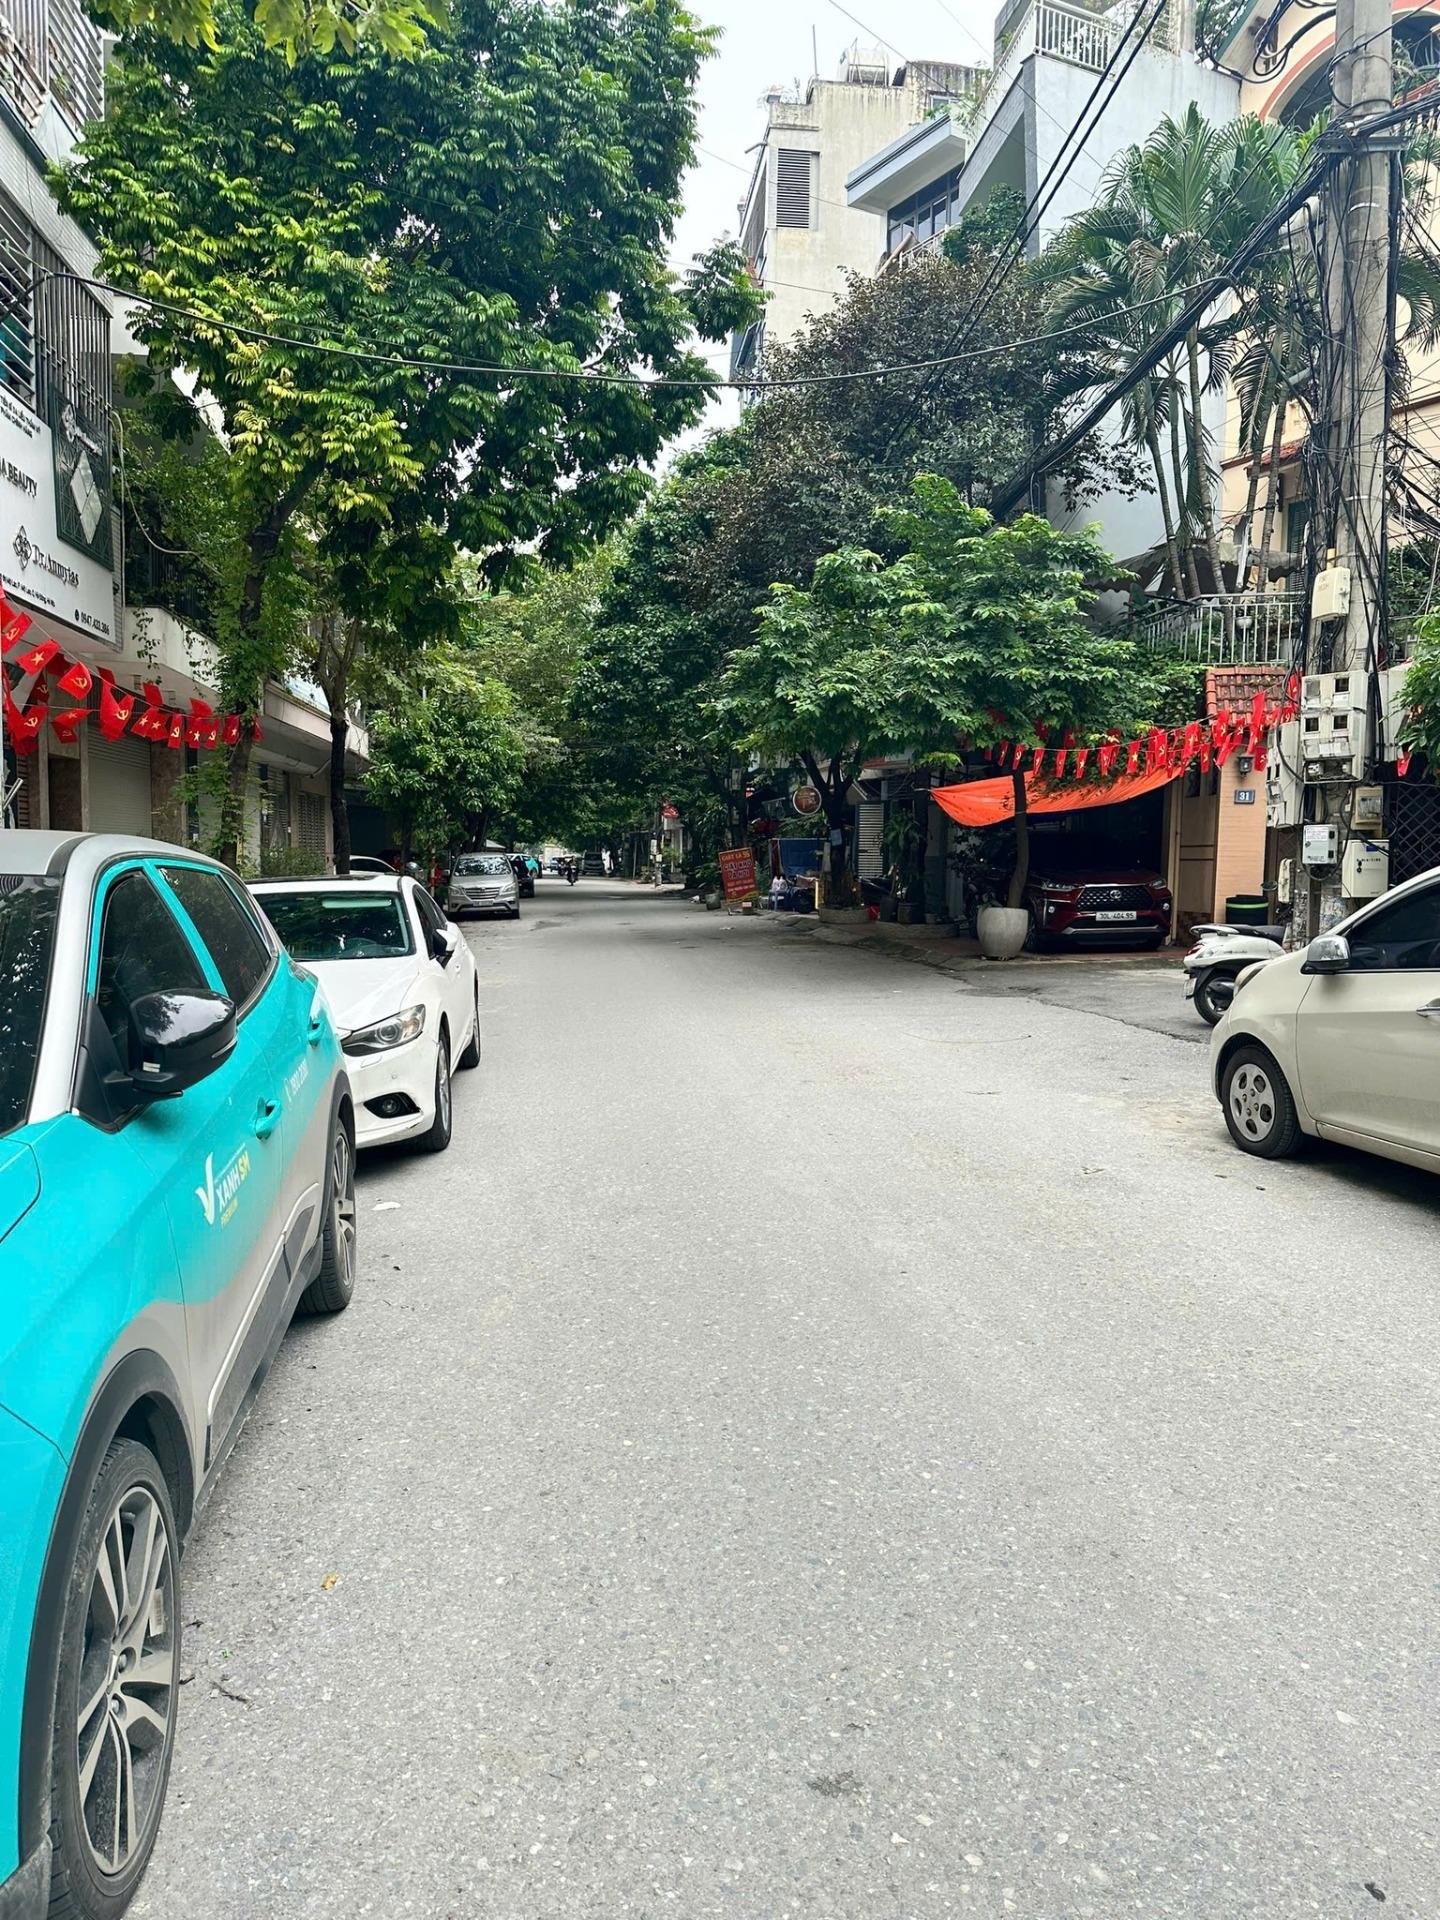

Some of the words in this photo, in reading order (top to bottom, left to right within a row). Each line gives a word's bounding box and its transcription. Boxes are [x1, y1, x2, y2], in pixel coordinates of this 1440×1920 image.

[7, 462, 38, 497] BEAUTY
[1239, 791, 1250, 801] 31
[216, 1164, 240, 1212] XANH
